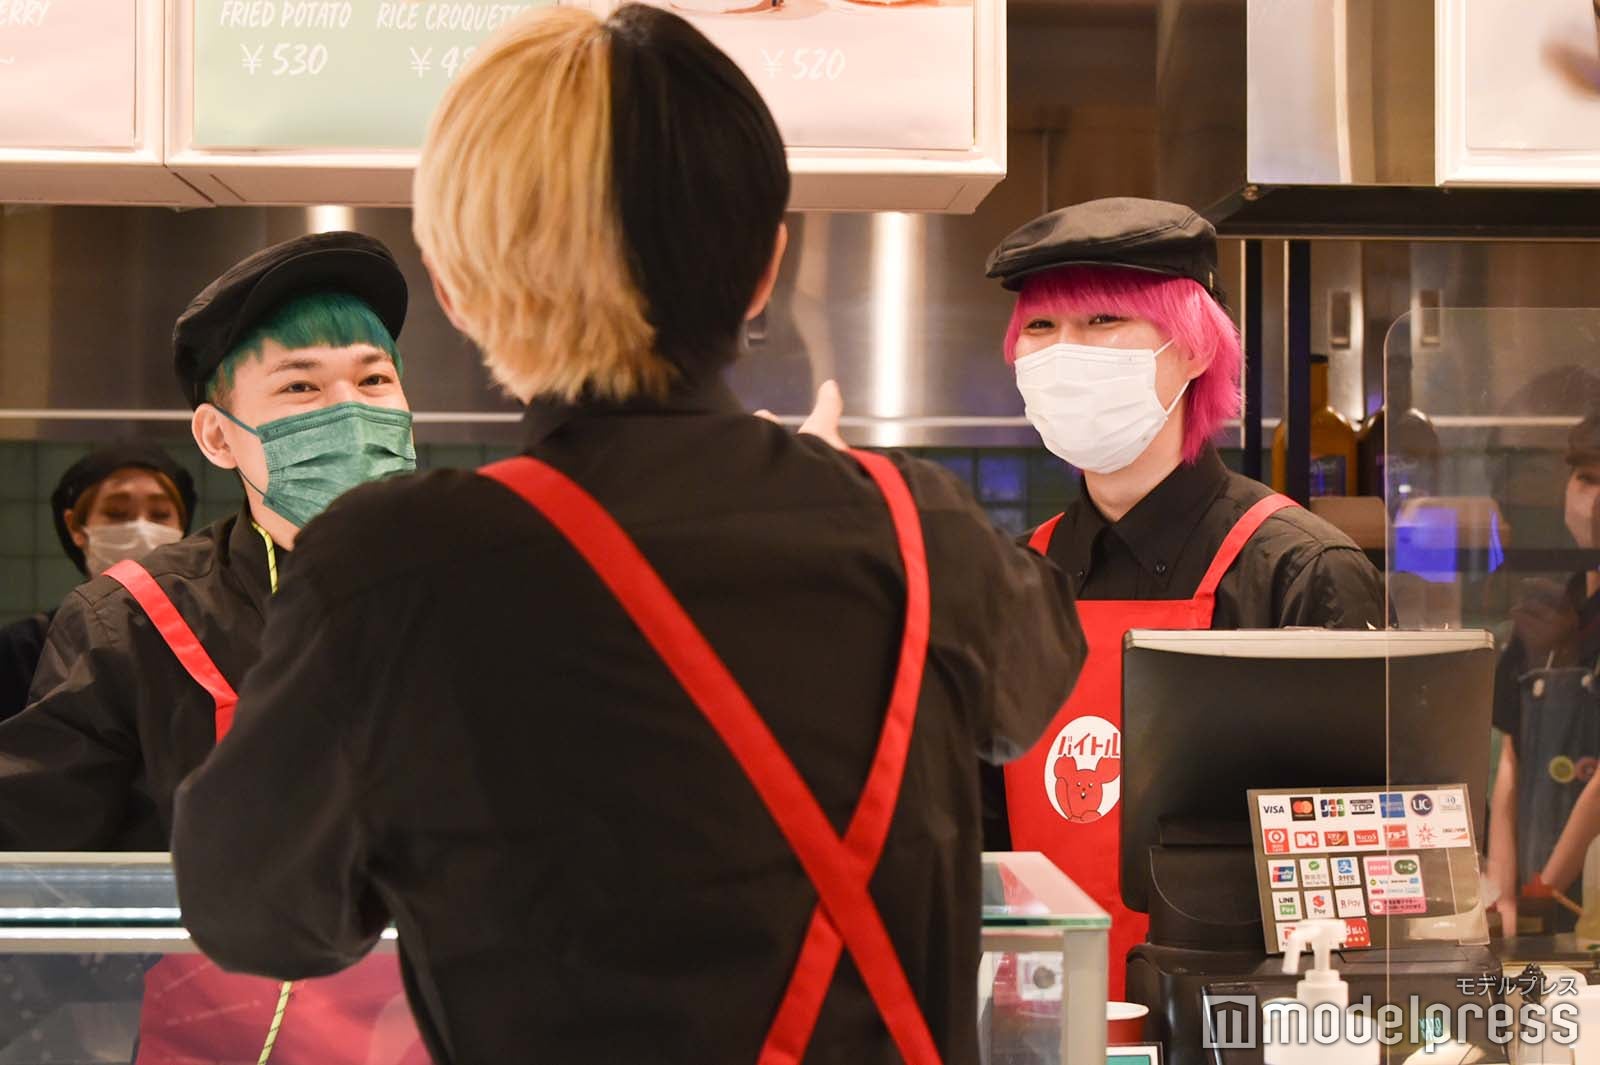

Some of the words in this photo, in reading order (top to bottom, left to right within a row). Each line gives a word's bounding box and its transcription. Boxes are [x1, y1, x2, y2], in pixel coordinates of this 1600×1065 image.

[219, 0, 275, 28] FRIED
[280, 0, 353, 28] POTATO
[376, 3, 420, 31] RICE
[1058, 732, 1120, 757] バイトル
[1263, 805, 1285, 814] VISA
[1320, 799, 1345, 817] JCB
[1351, 803, 1374, 812] TOP
[1412, 798, 1432, 811] UC
[1296, 832, 1318, 847] DC
